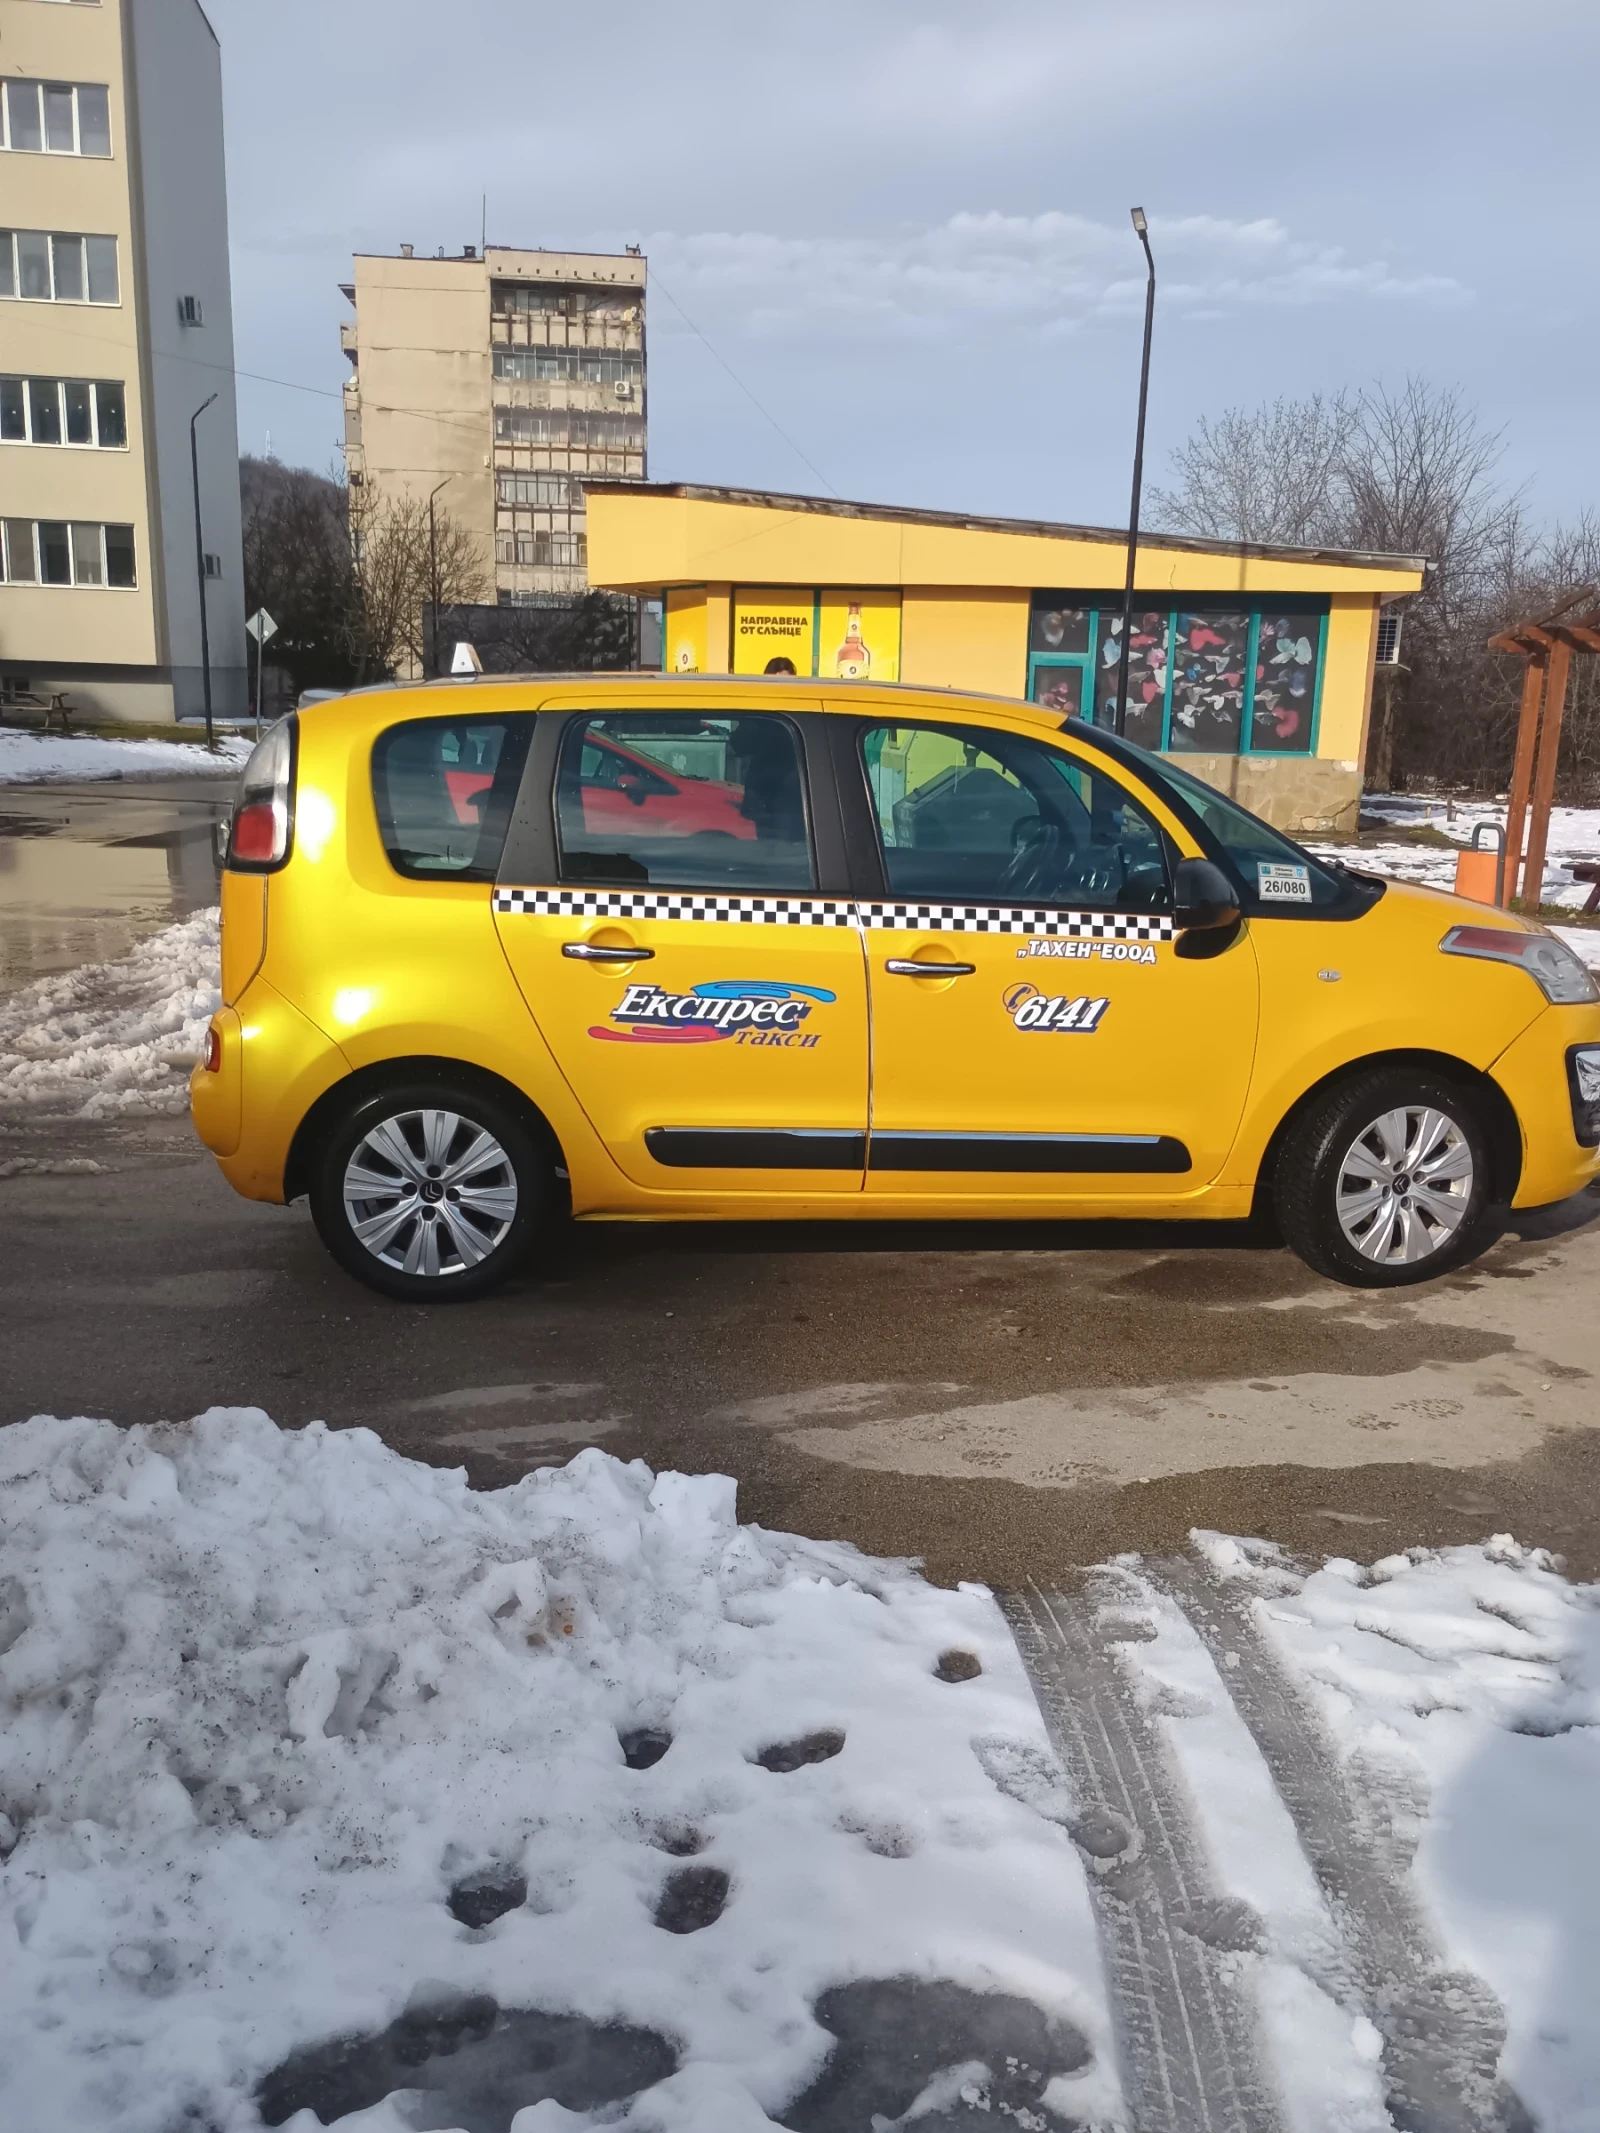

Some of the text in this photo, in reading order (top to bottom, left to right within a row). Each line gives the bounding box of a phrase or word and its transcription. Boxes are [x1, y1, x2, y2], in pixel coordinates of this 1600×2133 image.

[740, 616, 808, 626] НАПРАВЕНА
[740, 626, 801, 636] ОТ СЛЪНЦЕ
[1264, 880, 1306, 894] 26/080
[610, 985, 808, 1029] Експрес
[1013, 995, 1110, 1033] 6141
[735, 1030, 822, 1048] такси
